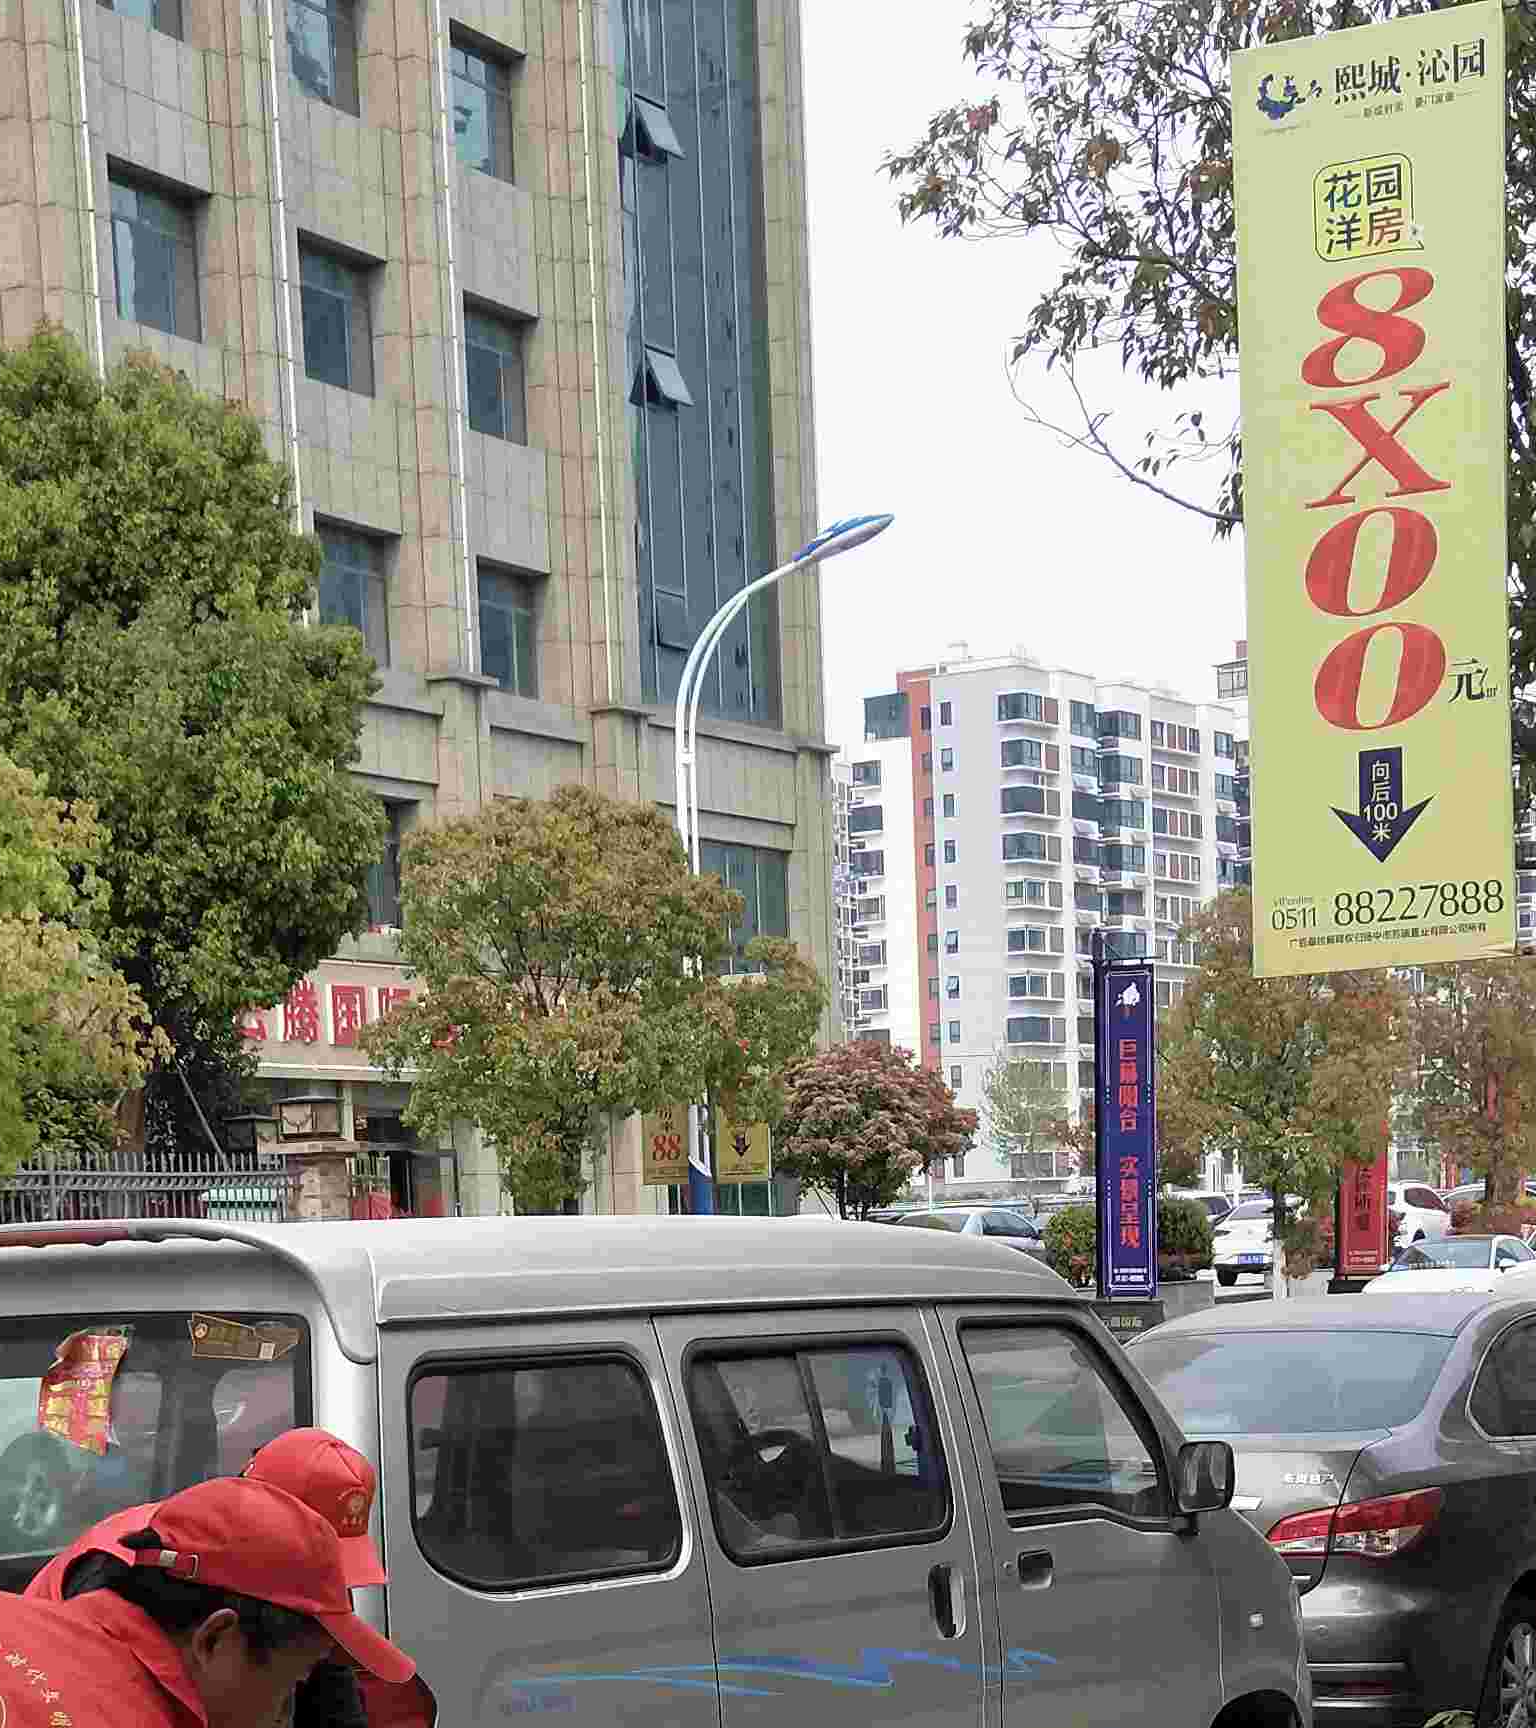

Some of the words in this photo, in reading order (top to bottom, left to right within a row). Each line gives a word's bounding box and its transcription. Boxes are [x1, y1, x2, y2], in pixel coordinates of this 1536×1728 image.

[1324, 163, 1403, 212] 花园
[1325, 206, 1405, 254] 洋房
[1271, 907, 1317, 930] 0511
[1334, 879, 1505, 927] 88227888
